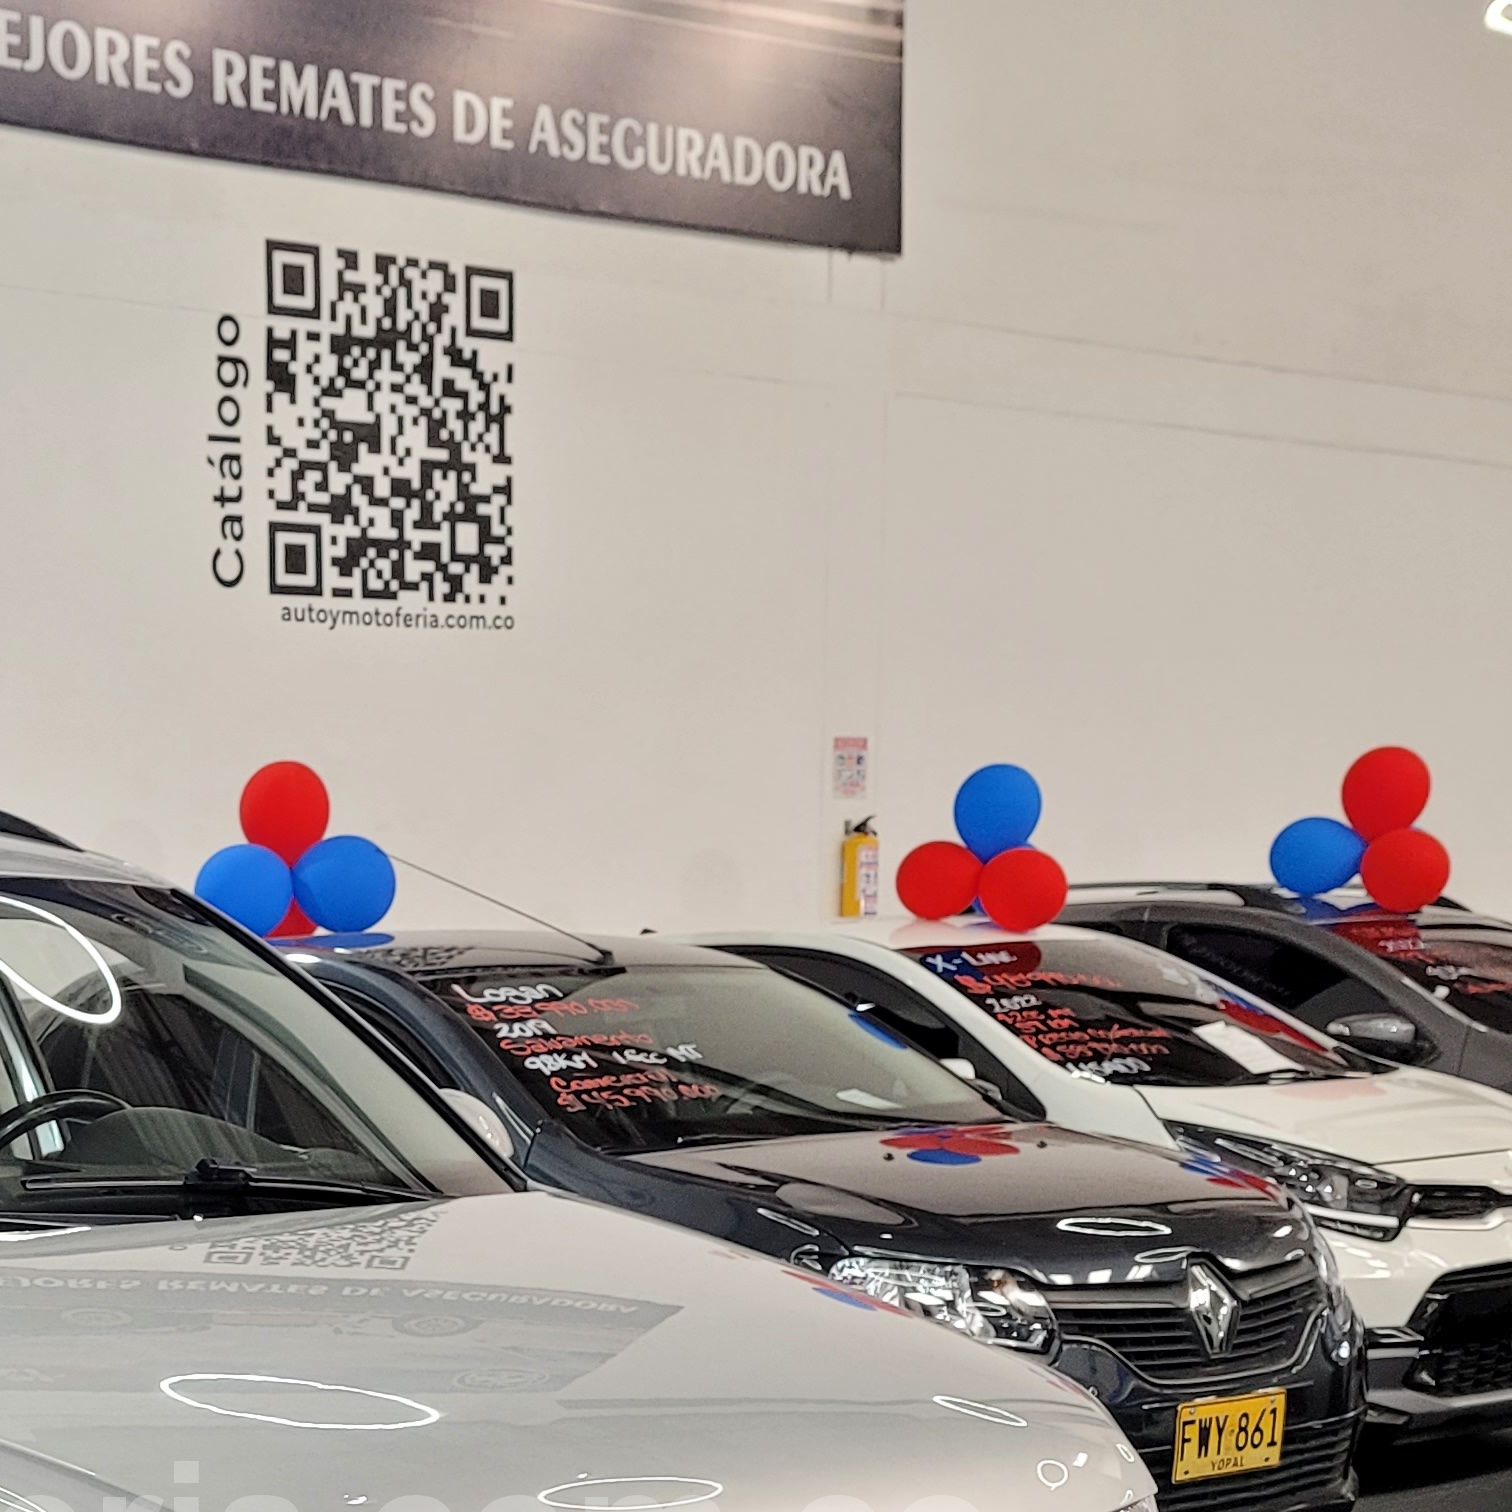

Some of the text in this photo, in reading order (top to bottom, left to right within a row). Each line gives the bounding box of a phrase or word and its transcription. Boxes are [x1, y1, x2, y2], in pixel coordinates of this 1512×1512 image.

[212, 47, 437, 139] REMATES
[452, 88, 515, 150] DE
[528, 103, 853, 200] ASEGURADORA
[207, 313, 249, 589] Catálogo
[280, 602, 516, 631] autoymotoferia.com.co
[450, 983, 564, 1004] Logan
[493, 1018, 559, 1039] 2019
[1180, 1406, 1278, 1462] FWY 861
[1210, 1456, 1245, 1472] YOPAL
